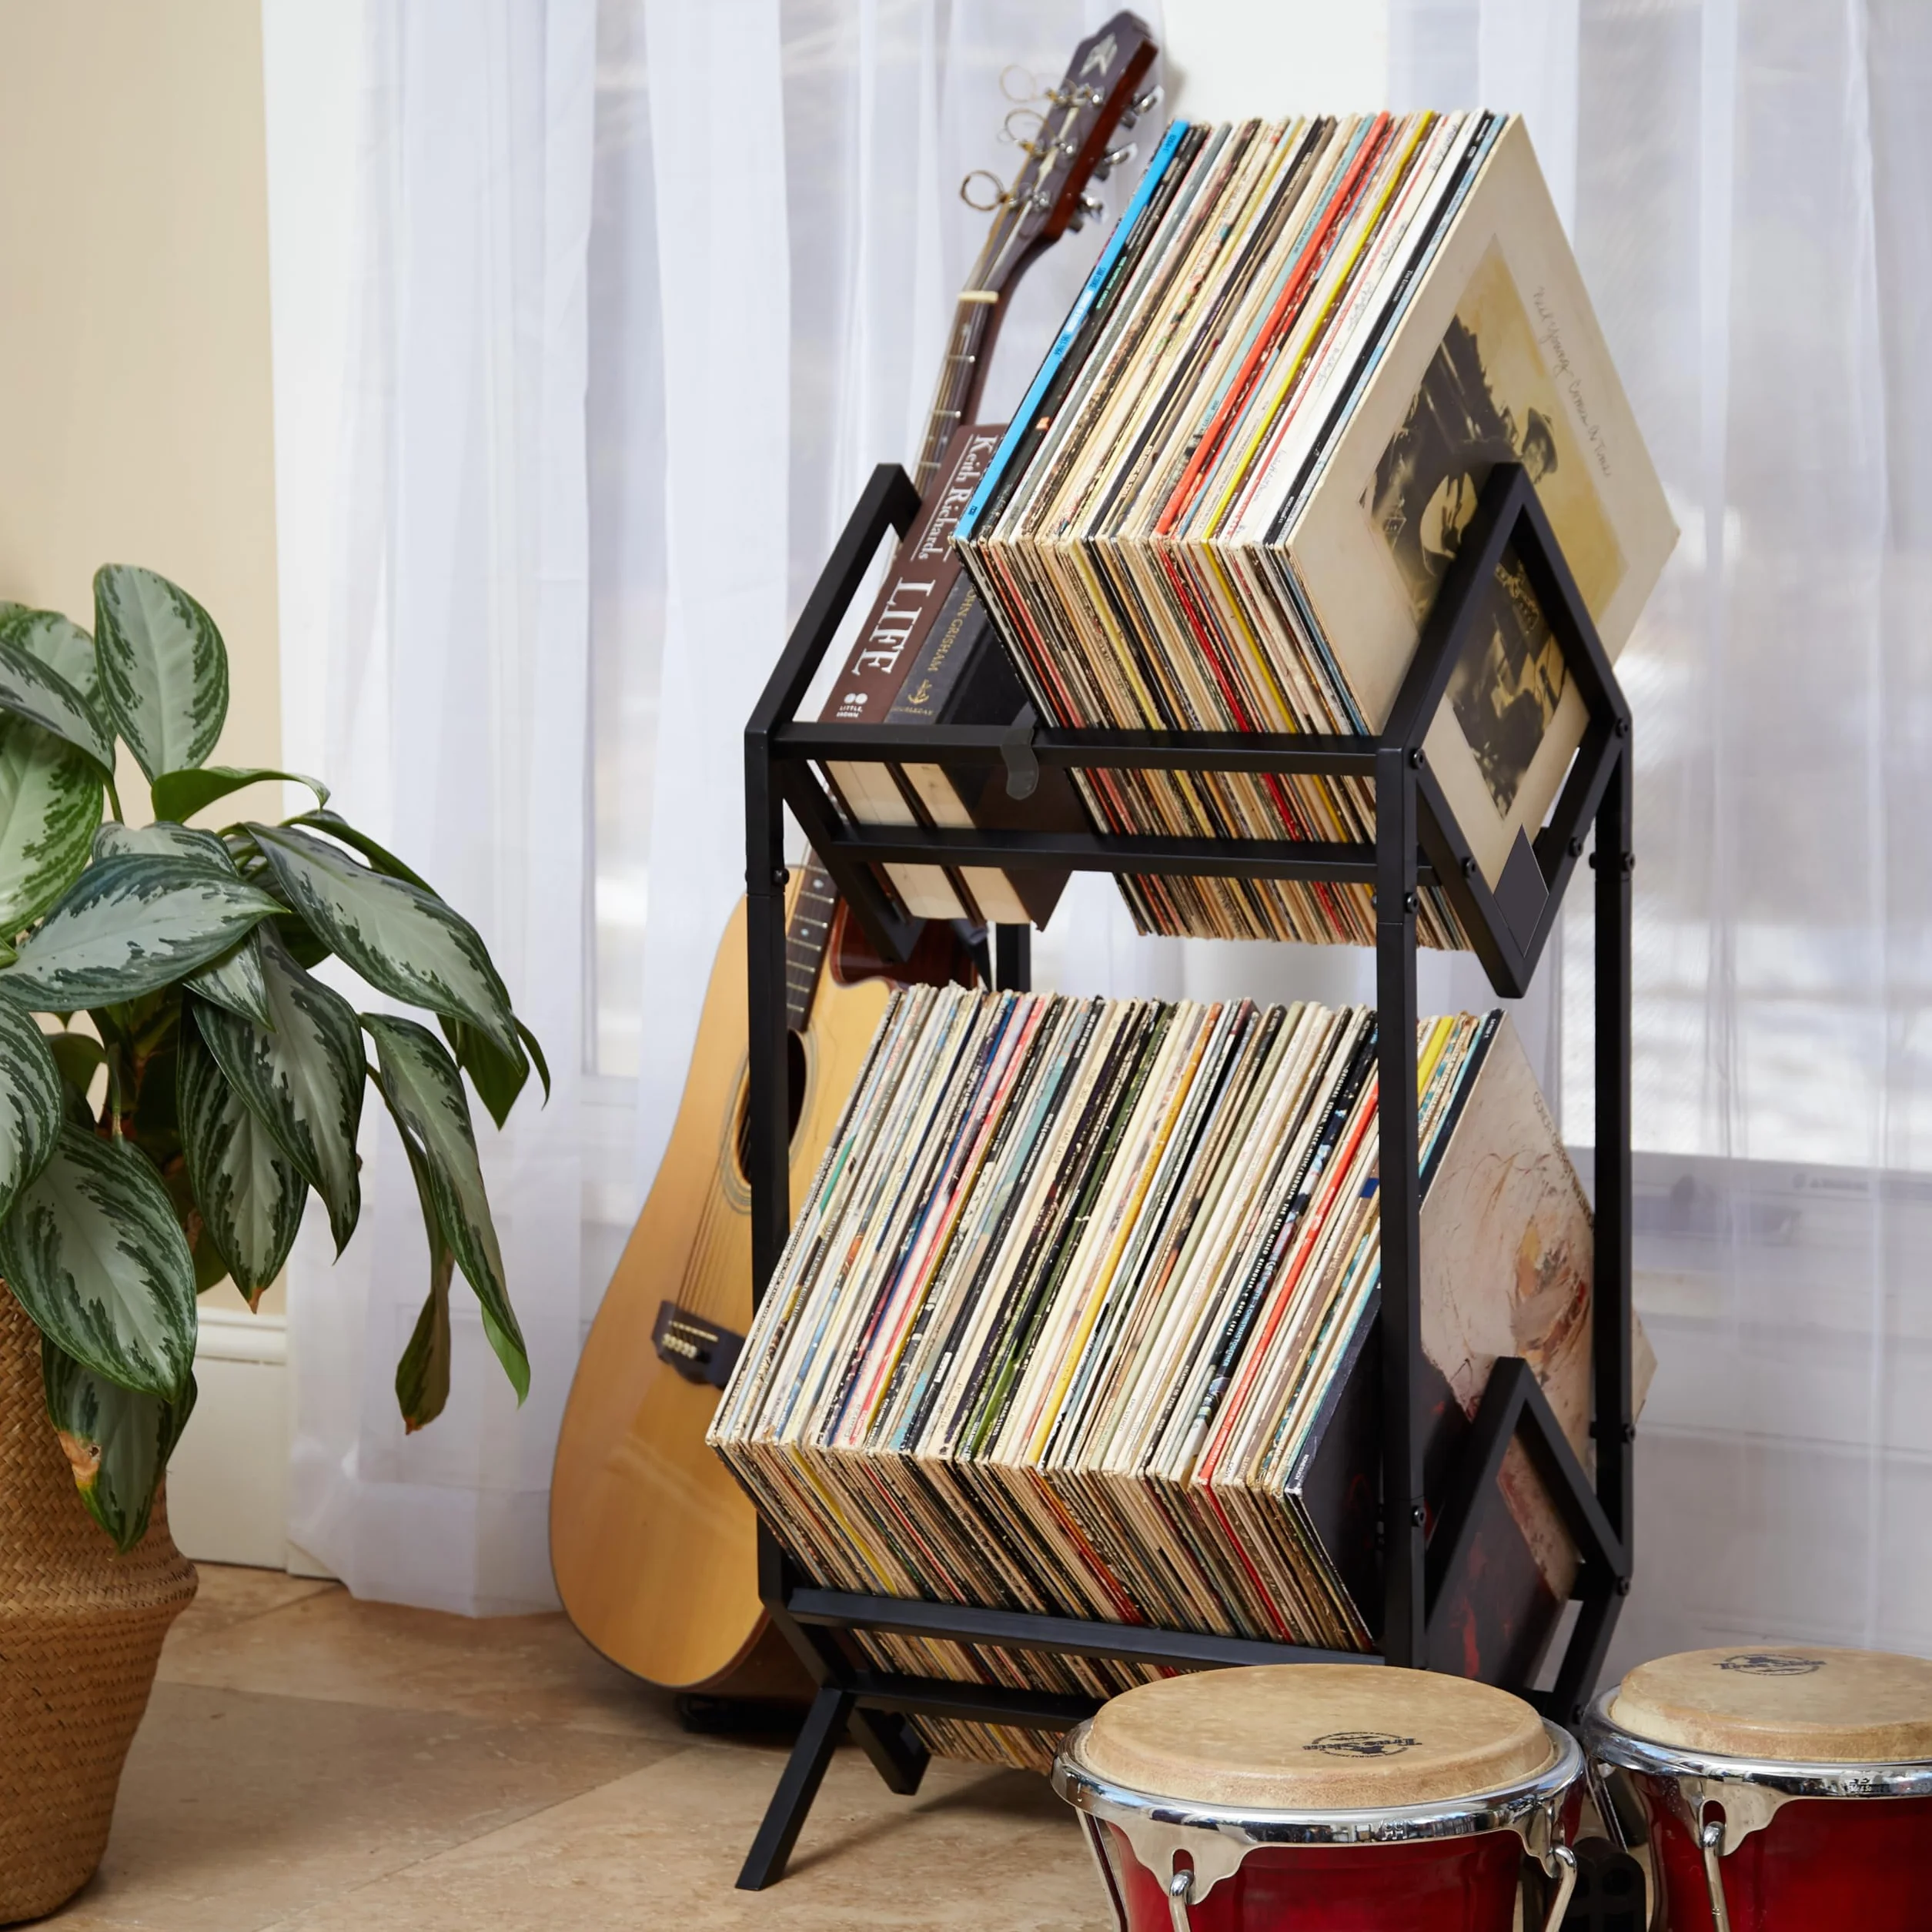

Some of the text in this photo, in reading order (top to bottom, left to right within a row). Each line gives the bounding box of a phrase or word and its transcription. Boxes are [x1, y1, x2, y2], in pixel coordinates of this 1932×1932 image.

[919, 434, 998, 560] Keith Richards
[851, 577, 937, 677] LIFE
[928, 618, 964, 672] GRISHAM
[1331, 1068, 1348, 1098] ORIGINAL
[1320, 1101, 1333, 1122] SOUND
[1279, 1203, 1289, 1215] THE
[1272, 1218, 1282, 1230] RED
[1261, 1234, 1275, 1254] NOSED
[1246, 1258, 1264, 1288] REINDEER
[1233, 1301, 1245, 1315] BURL
[1225, 1320, 1237, 1336] IVES
[1234, 1309, 1252, 1339] CHRISTMAS
[1222, 1338, 1239, 1366] TOGETHER
[1176, 1365, 1189, 1386] ATLANTIC
[874, 1398, 889, 1426] COLUMBIA
[1089, 1398, 1115, 1448] COLUMBIA STEREO
[1118, 1398, 1135, 1431] EPIC STEREO
